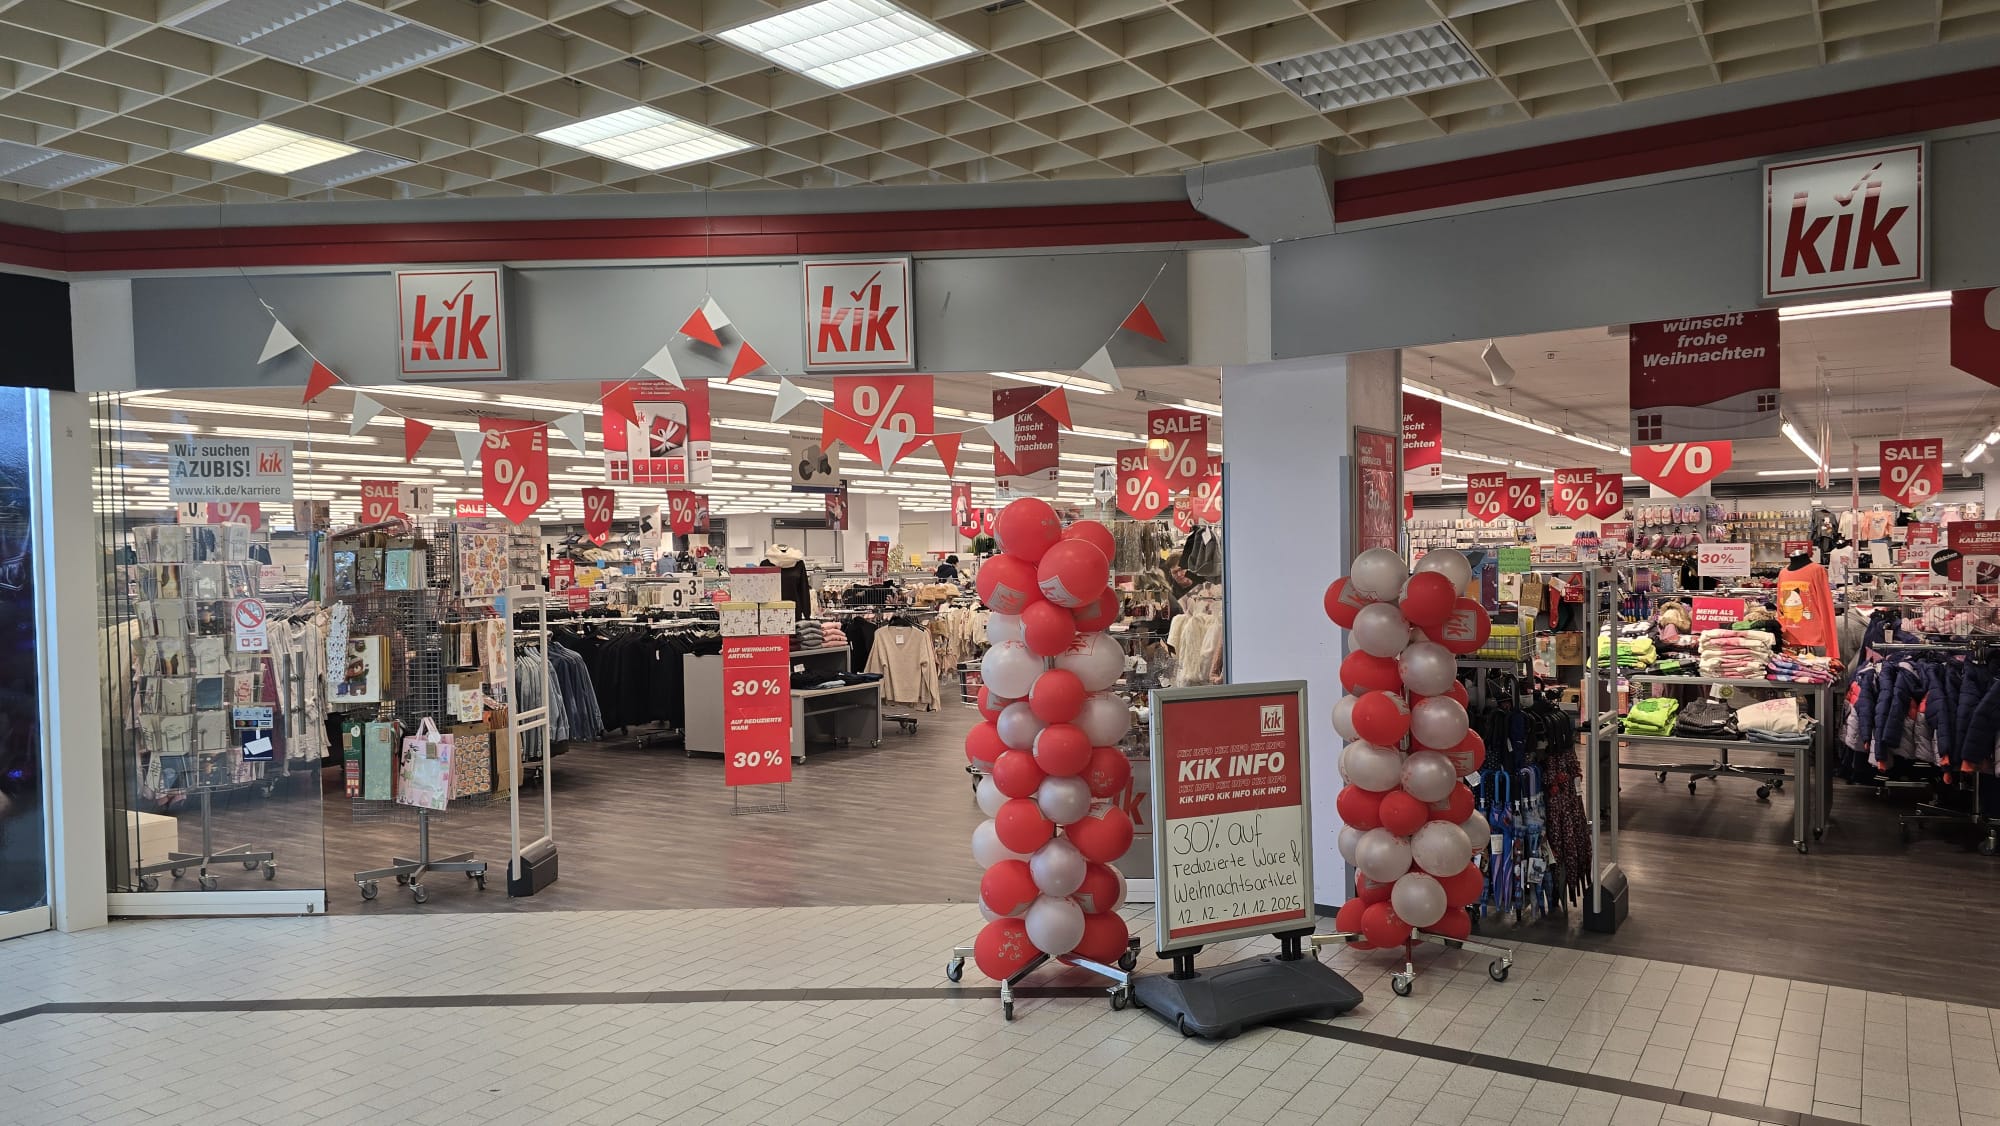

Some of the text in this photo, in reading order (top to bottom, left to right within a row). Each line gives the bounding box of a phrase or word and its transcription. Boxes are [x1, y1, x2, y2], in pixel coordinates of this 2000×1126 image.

[1781, 162, 1909, 278] kik
[411, 280, 491, 361] kik
[818, 270, 899, 353] kik
[1663, 313, 1744, 333] wünscht
[1677, 332, 1728, 348] frohe
[1643, 346, 1766, 367] Weihnachten
[1018, 413, 1033, 422] KiK
[1153, 415, 1202, 434] SALE
[1403, 413, 1414, 421] iK
[1403, 422, 1420, 430] scht
[1015, 422, 1044, 432] ünscht
[486, 428, 543, 451] SAE
[1016, 442, 1053, 451] nachten
[1403, 440, 1435, 448] achten
[175, 444, 250, 457] Wir suchen
[1160, 439, 1197, 479] %
[1885, 445, 1937, 460] SALE
[175, 460, 250, 477] AZUBIS!
[259, 452, 282, 473] kik
[1121, 456, 1148, 471] SAL
[494, 459, 538, 506] %
[1471, 478, 1503, 488] SALE
[1557, 473, 1593, 484] SALE
[1890, 465, 1931, 497] %
[175, 485, 281, 496] www.kik.de/karriere
[364, 485, 399, 498] SALE
[1126, 476, 1159, 511] %
[1509, 485, 1535, 508] %
[1561, 487, 1589, 512] %
[458, 504, 485, 513] SALE
[588, 496, 610, 519] %
[672, 498, 692, 523] %
[1474, 491, 1500, 514] %
[1700, 553, 1735, 564] 30%
[688, 580, 696, 595] 3
[673, 589, 682, 606] 9
[731, 680, 759, 696] 30
[1264, 709, 1282, 729] kik
[733, 751, 760, 768] 30
[1178, 751, 1285, 782] KiK INFO
[1179, 785, 1287, 804] KiK INFO KiK INFO KiK INFO
[1173, 814, 1263, 855] 30% auf
[1172, 852, 1247, 878] reduzierte
[1252, 847, 1286, 868] Ware
[1173, 870, 1298, 904] Weihnachtsartikel
